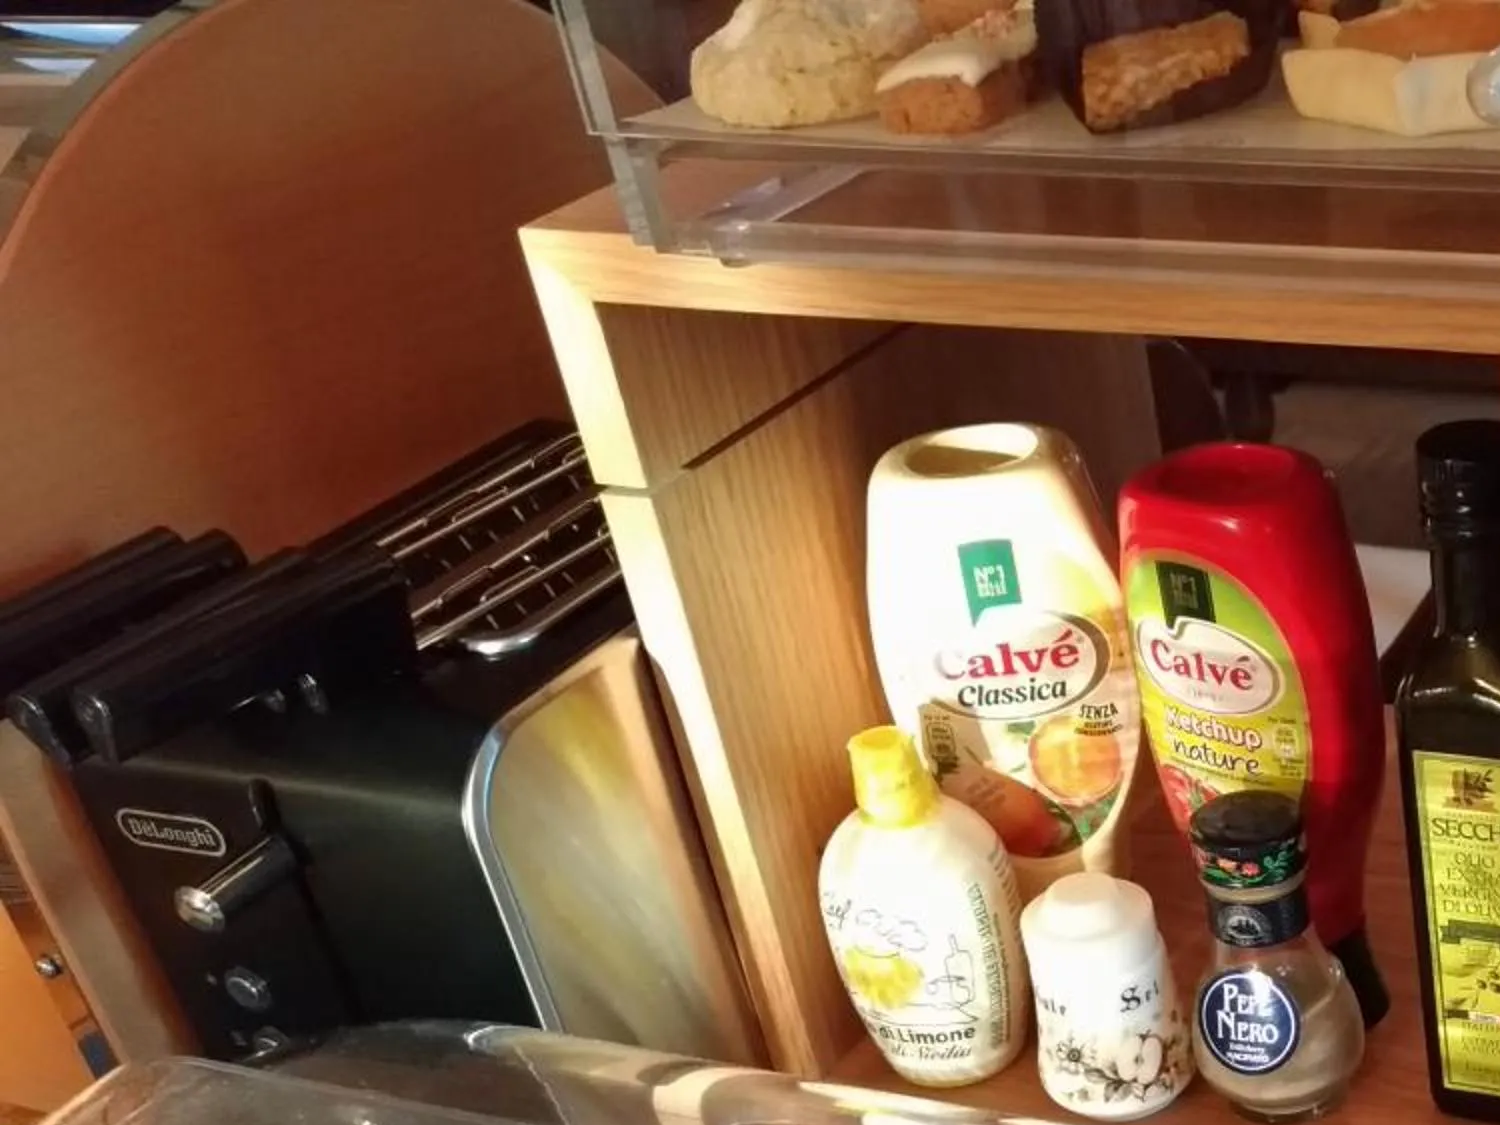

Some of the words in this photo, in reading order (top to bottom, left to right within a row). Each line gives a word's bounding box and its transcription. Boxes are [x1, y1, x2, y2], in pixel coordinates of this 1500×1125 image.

[1150, 638, 1253, 692] Calvé
[957, 676, 1068, 708] Classica
[1163, 704, 1263, 753] Ketchup
[1173, 737, 1260, 776] nature
[897, 1026, 976, 1045] Limone
[1216, 1010, 1280, 1044] NERO
